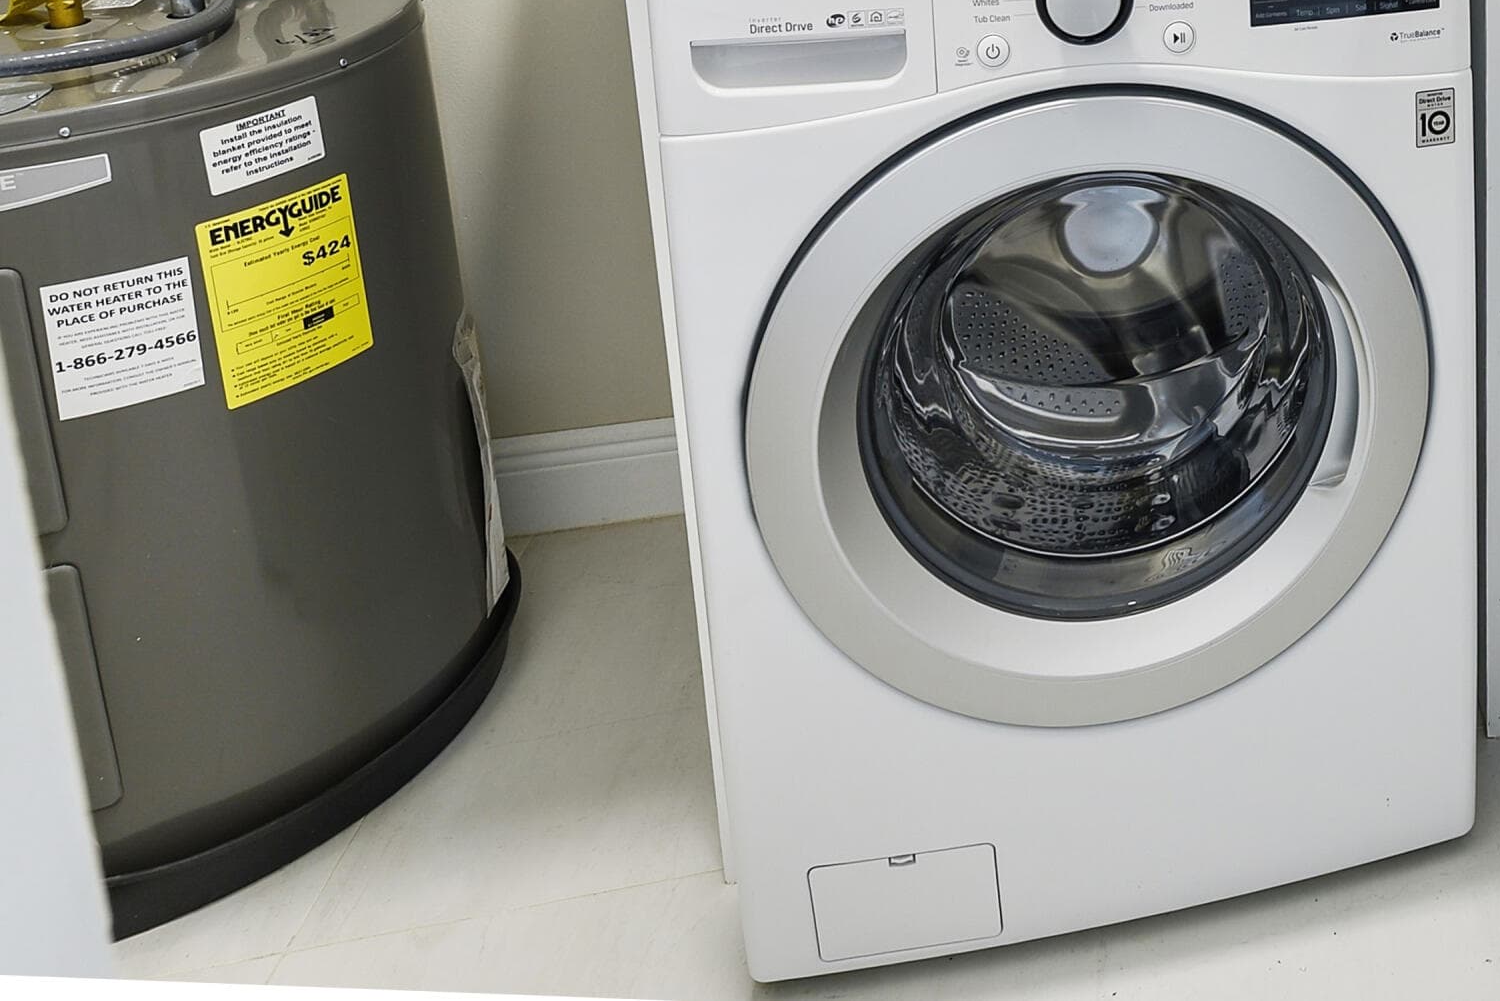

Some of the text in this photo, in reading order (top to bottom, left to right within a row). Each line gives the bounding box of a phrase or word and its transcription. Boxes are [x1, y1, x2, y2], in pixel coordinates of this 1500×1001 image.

[972, 0, 1000, 7] Whites
[973, 15, 988, 23] Tub
[1149, 2, 1194, 12] Downloaded
[750, 21, 814, 34] Direct Drive
[221, 115, 302, 145] Install the insulation
[236, 110, 286, 131] IMPORTANT
[1420, 111, 1450, 137] 10
[212, 155, 242, 169] energy
[245, 141, 284, 158] efficiency
[285, 131, 311, 144] ratings
[213, 143, 245, 157] blanket
[247, 131, 282, 148] provided
[294, 120, 312, 131] meet
[221, 163, 242, 175] refer
[254, 155, 268, 164] the
[269, 140, 311, 158] installation
[246, 156, 294, 176] instructions
[209, 185, 342, 246] ENERGYGUIDE
[302, 235, 351, 266] $424
[47, 279, 188, 316] WATER HEATER TO THE
[49, 267, 184, 303] DO NOT RETURN THIS
[57, 293, 184, 328] PLACE OF PURCHASE
[55, 330, 197, 374] 1-866-279-4566
